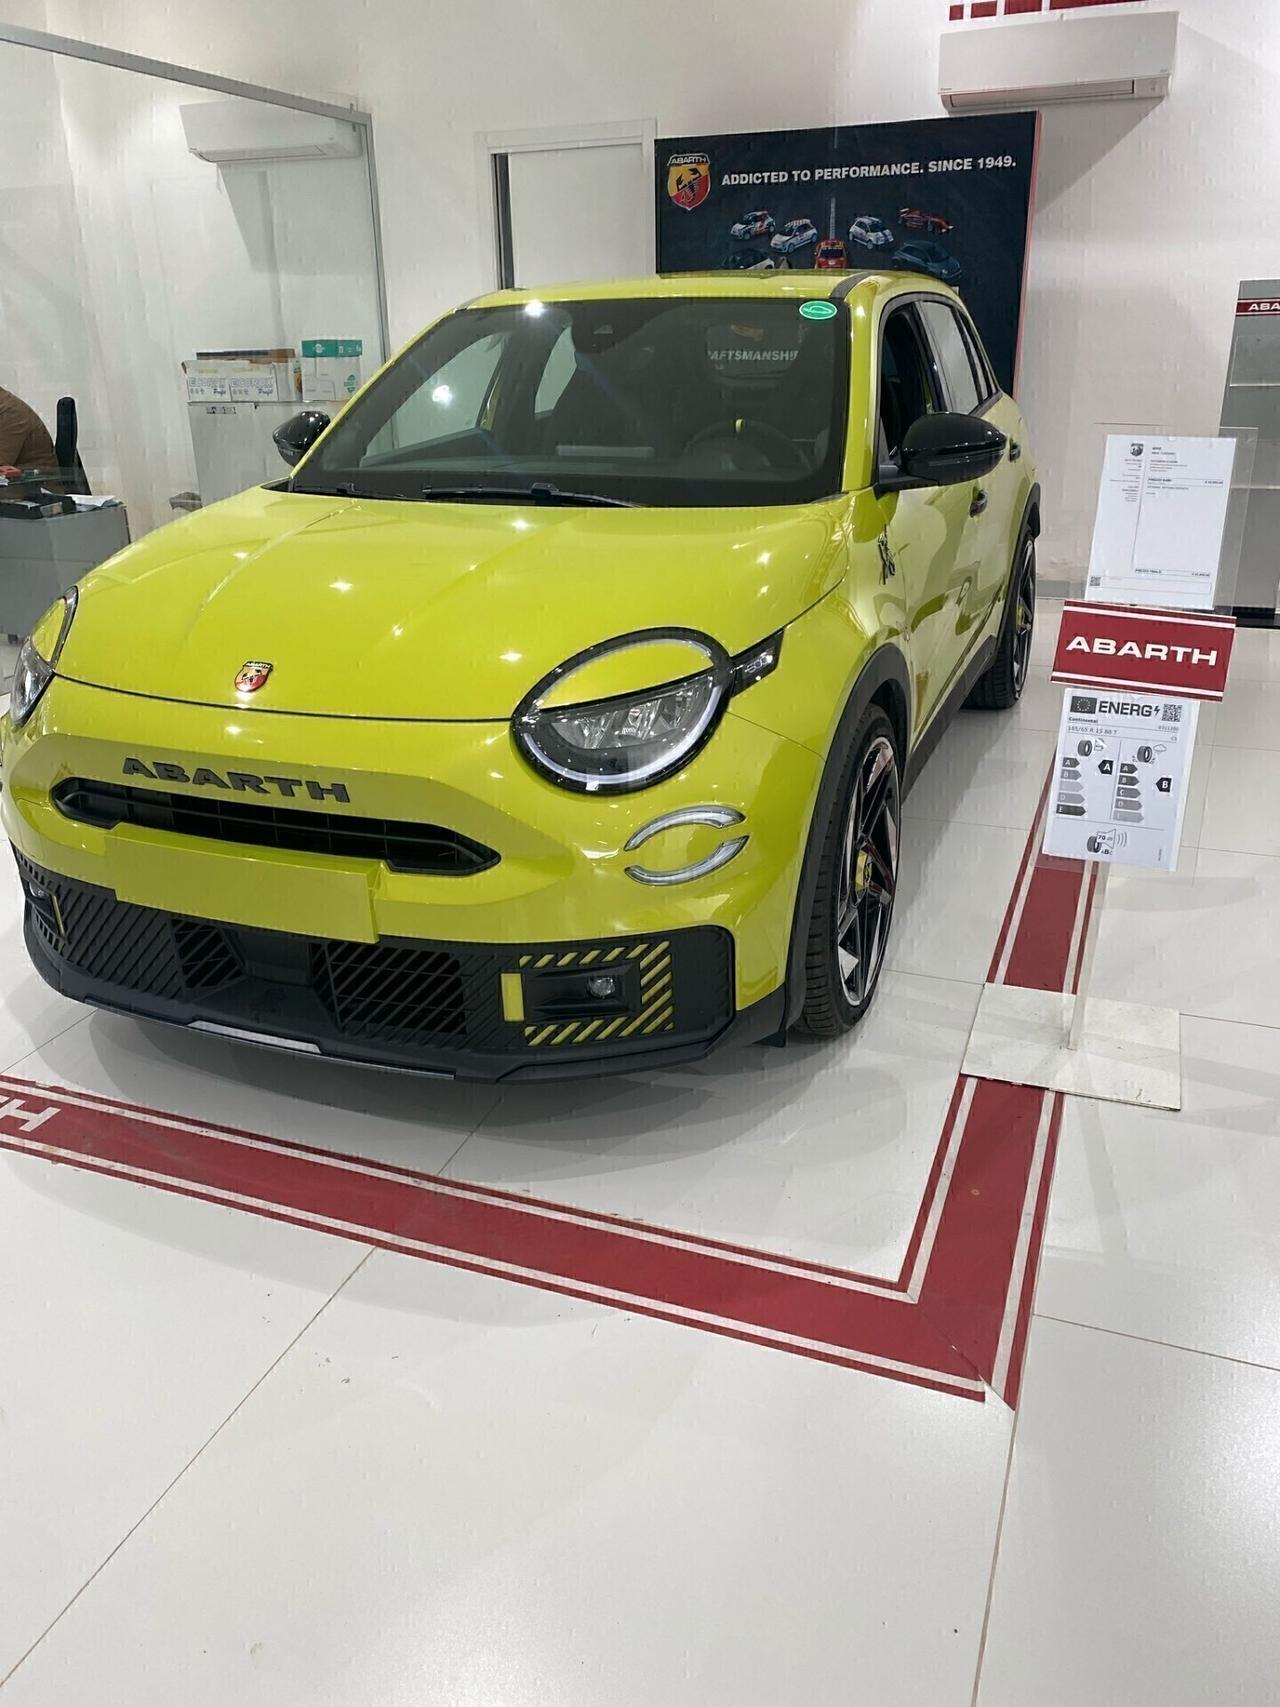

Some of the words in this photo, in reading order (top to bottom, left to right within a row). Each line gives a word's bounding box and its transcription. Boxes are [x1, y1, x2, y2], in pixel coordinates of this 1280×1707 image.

[671, 156, 706, 164] ABARTH
[721, 171, 788, 186] ADDICTED
[792, 169, 811, 182] TO
[815, 162, 924, 181] PERFORMANCE.
[928, 157, 973, 173] SINCE
[977, 155, 1016, 169] 1949.
[1065, 635, 1218, 666] ABARTH
[1098, 700, 1153, 717] ENERG
[122, 757, 350, 803] ABARTH
